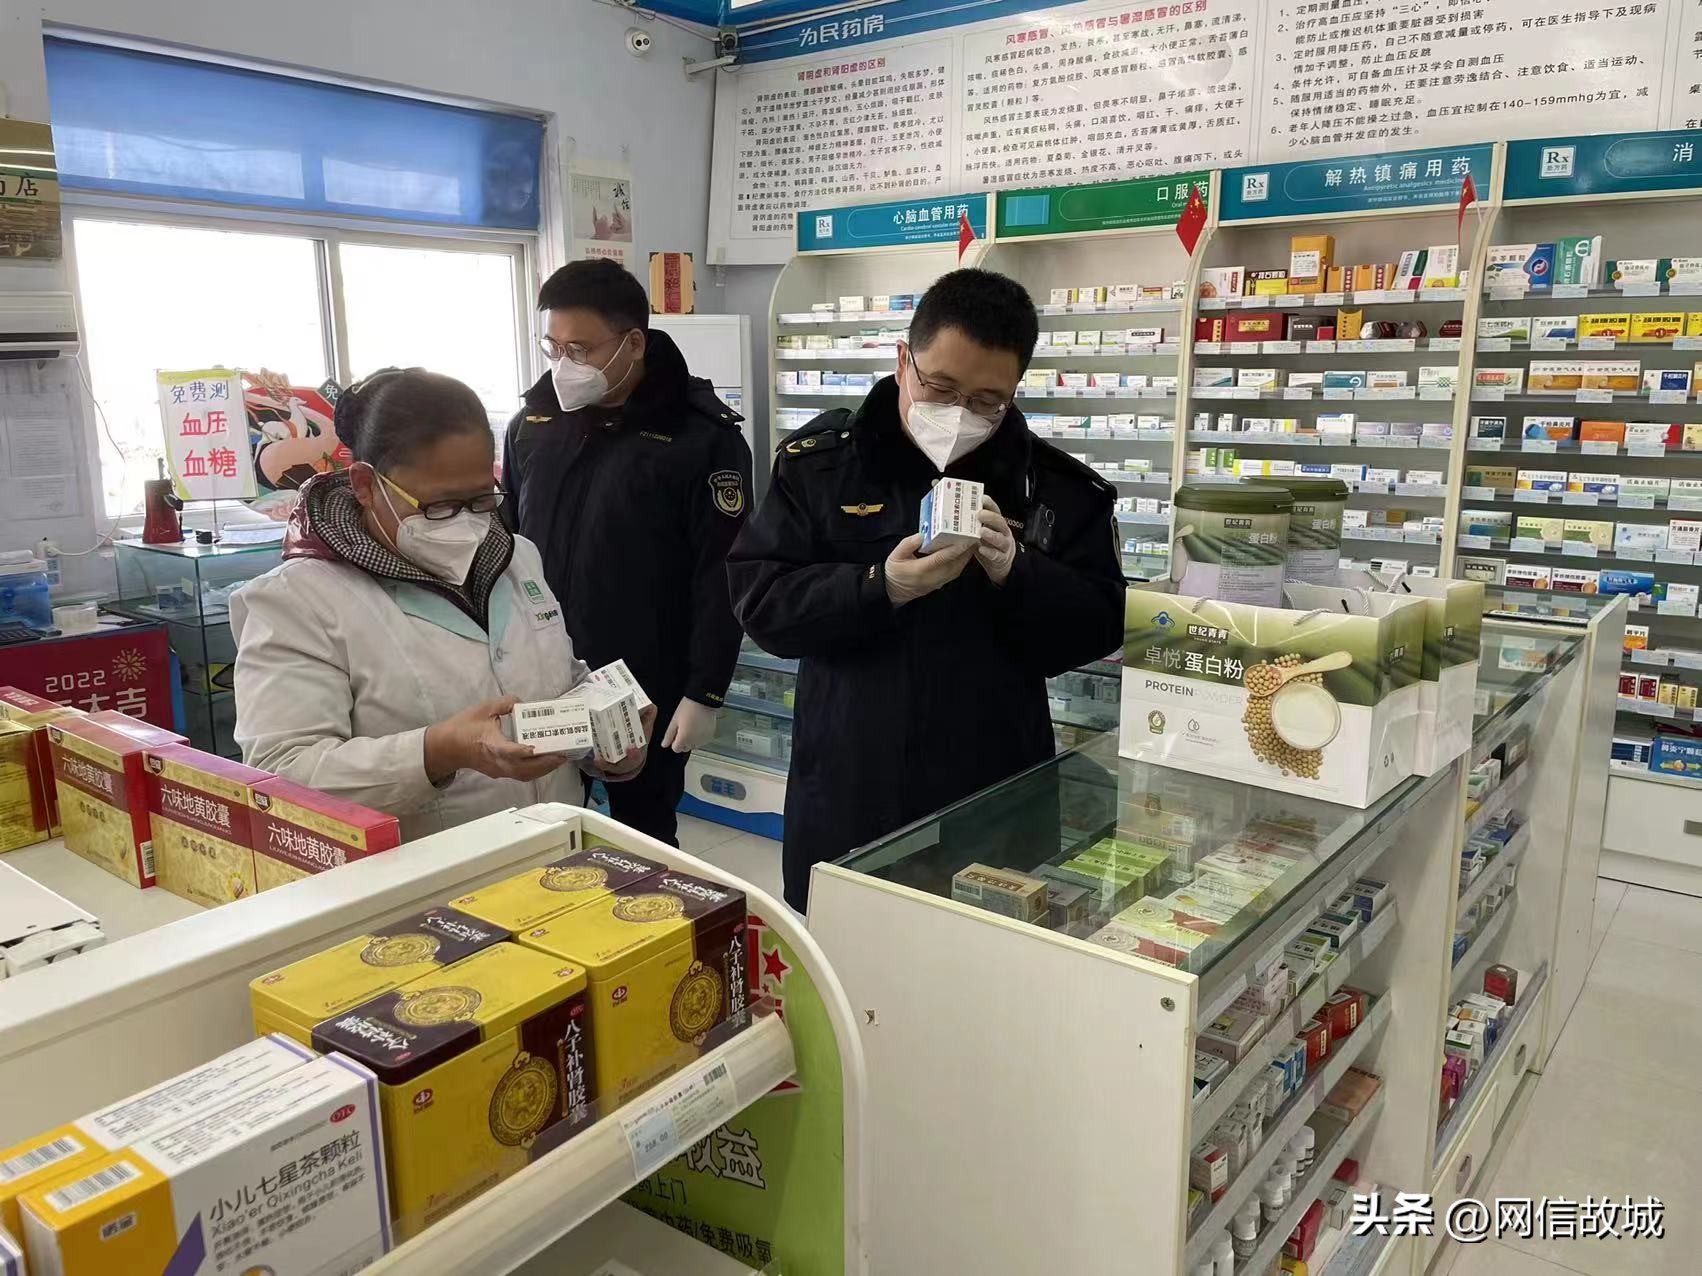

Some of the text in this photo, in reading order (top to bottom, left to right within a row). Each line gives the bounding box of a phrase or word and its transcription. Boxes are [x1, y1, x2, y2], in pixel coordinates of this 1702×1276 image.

[799, 14, 884, 47] 为民药房
[1547, 151, 1569, 163] Rx
[1672, 142, 1694, 162] 消
[1247, 178, 1264, 188] Rx
[1325, 156, 1471, 187] 解热镇痛用药
[893, 203, 969, 225] 心脑血管用药
[170, 380, 230, 404] 免费测
[180, 411, 228, 436] 血压
[182, 447, 237, 478] 血糖
[1188, 625, 1228, 640] 世纪青青
[45, 670, 106, 693] 2022
[1145, 680, 1194, 697] PROTEIN
[57, 687, 147, 718] 大吉
[62, 756, 113, 794] 六味地黄胶囊
[160, 784, 232, 828] 六味地黄胶囊
[267, 822, 347, 868] 六味地黄胶囊
[333, 1104, 355, 1121] OTC
[209, 1129, 362, 1222] 小儿七星茶颗粒
[211, 1151, 363, 1239] Xiao'er Qixingcha Keli
